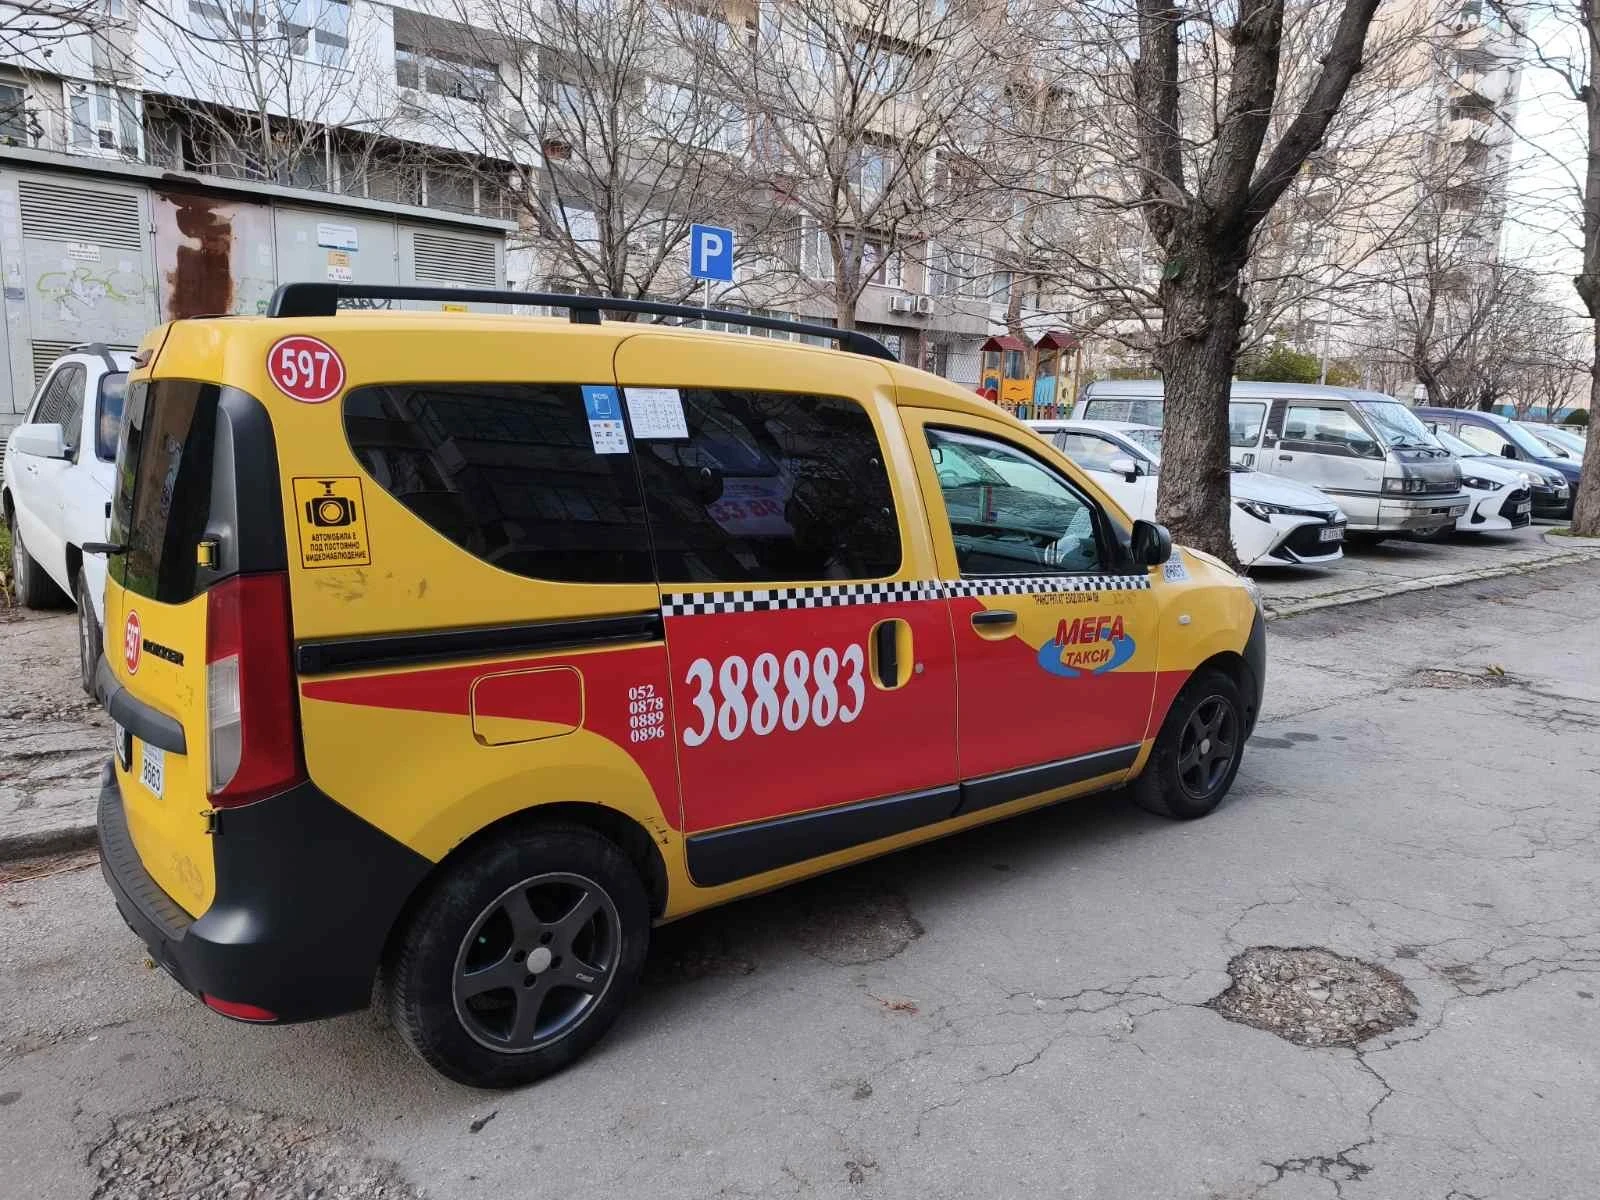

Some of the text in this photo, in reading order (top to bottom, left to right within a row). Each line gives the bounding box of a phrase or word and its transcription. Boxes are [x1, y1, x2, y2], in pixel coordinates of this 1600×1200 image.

[701, 232, 723, 272] P
[282, 348, 330, 389] 597
[310, 543, 323, 551] ПОД
[125, 621, 139, 664] 597
[1055, 614, 1125, 648] МЕГА
[1066, 649, 1110, 665] ТАКСИ
[628, 684, 655, 700] 052
[683, 643, 866, 747] 388883
[629, 697, 664, 715] 0878
[629, 711, 664, 729] 0889
[631, 726, 665, 743] 0896
[143, 758, 161, 792] 8663
